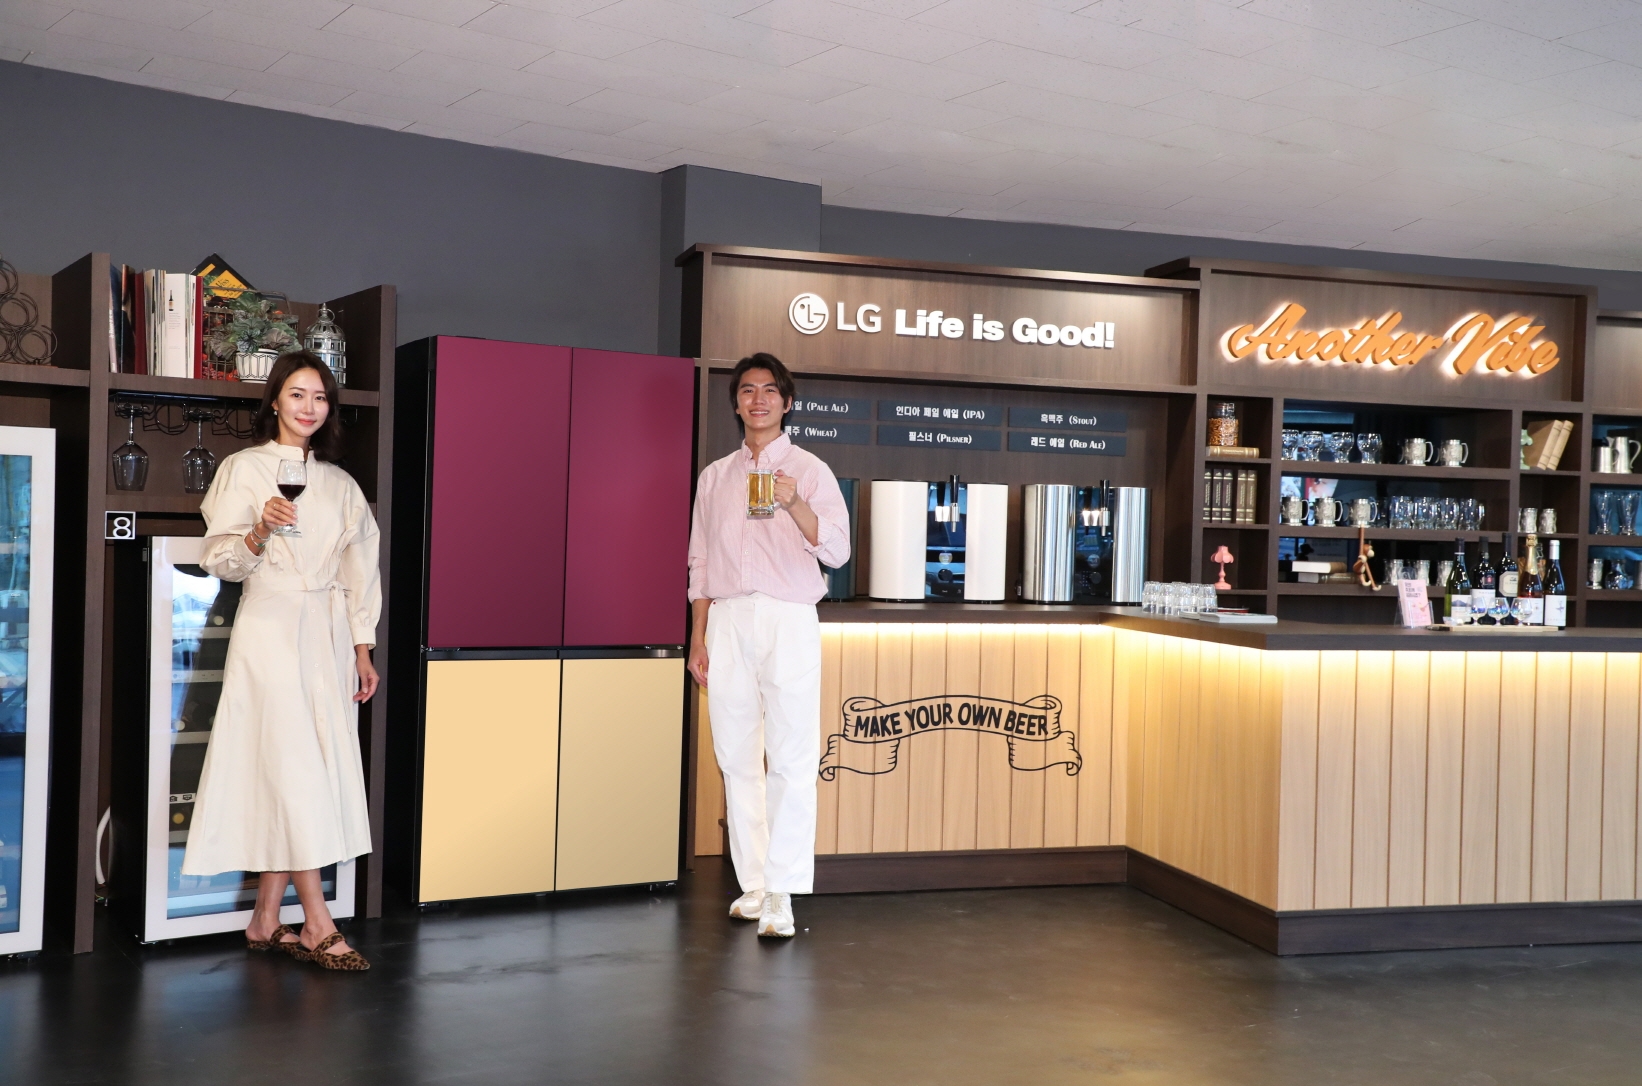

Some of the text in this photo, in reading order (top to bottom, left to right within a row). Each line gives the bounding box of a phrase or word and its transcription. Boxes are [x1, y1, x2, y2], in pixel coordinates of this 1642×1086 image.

[836, 301, 1115, 348] LG Life is Good!
[1228, 303, 1560, 376] Another Vibe
[791, 400, 803, 411] 일
[895, 405, 985, 420] 인디아 페일 에일 (IPA)
[1040, 413, 1064, 424] 흑맥주
[908, 431, 933, 443] 필스너
[1030, 436, 1046, 447] 레드
[1049, 437, 1065, 448] 에일
[853, 702, 1049, 738] MAKE YOUR OWN BEER
